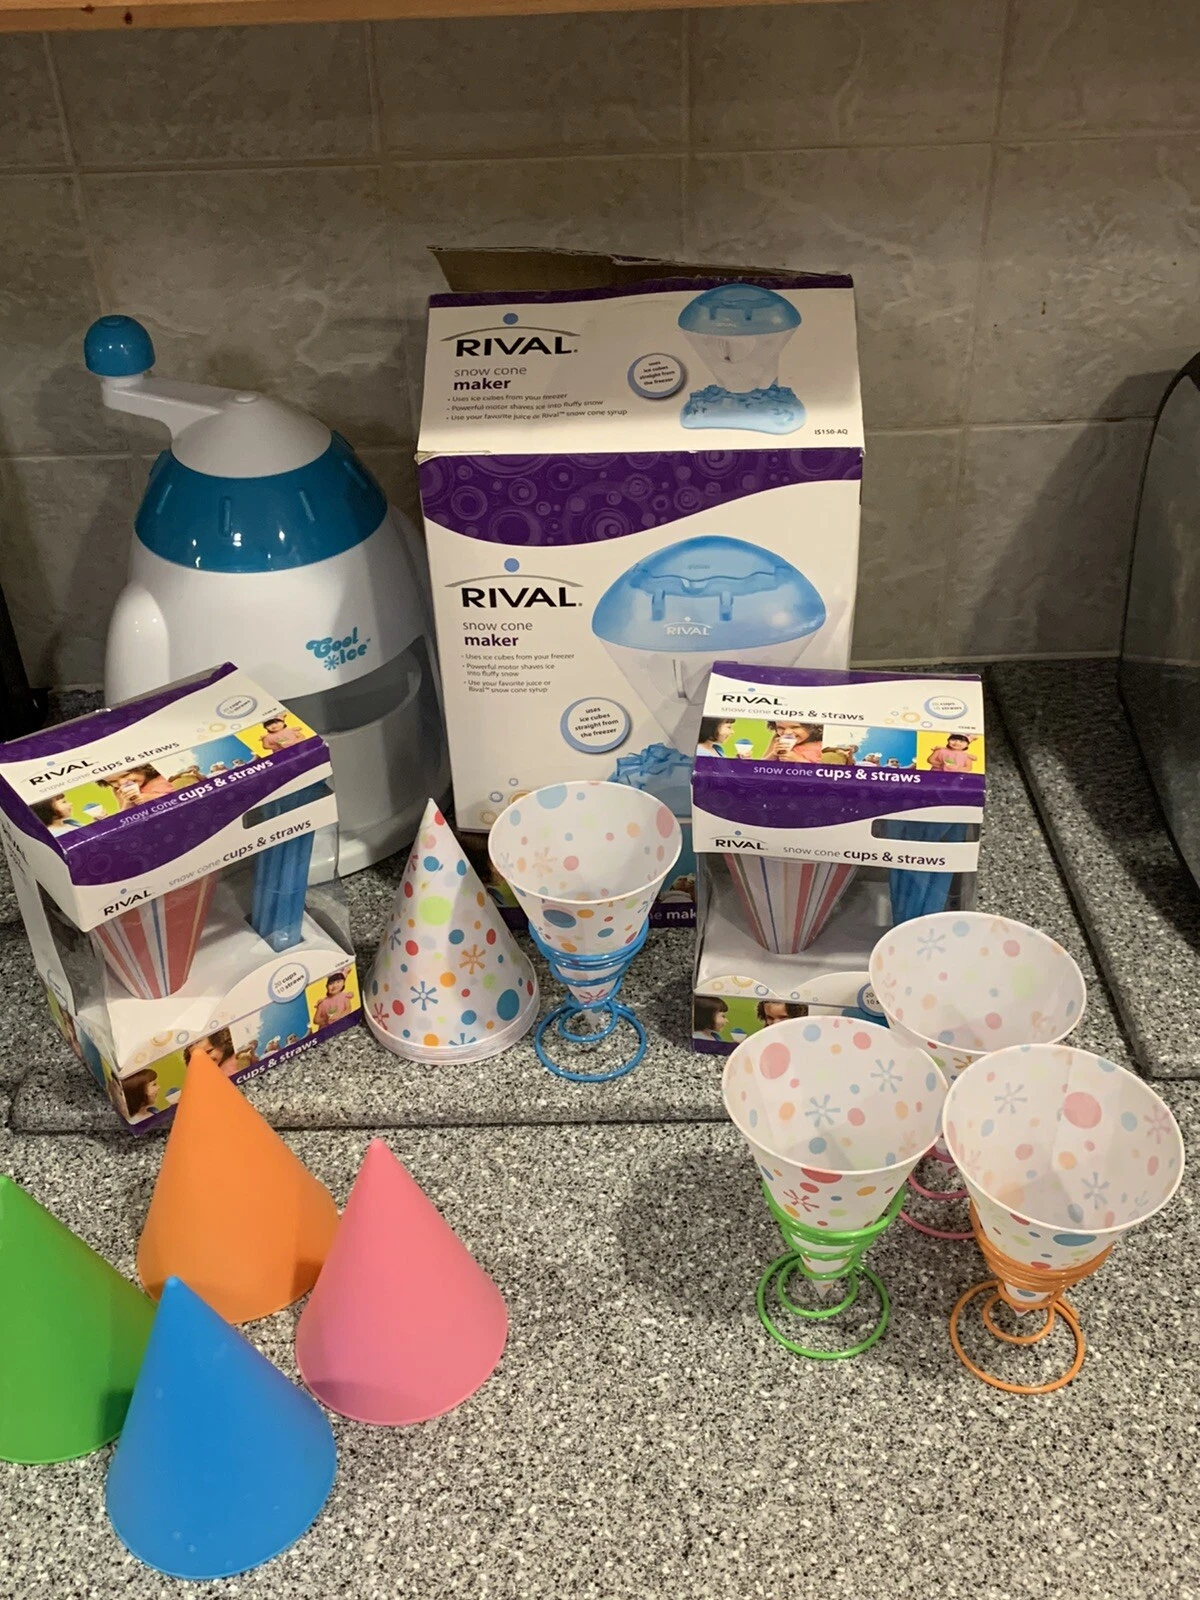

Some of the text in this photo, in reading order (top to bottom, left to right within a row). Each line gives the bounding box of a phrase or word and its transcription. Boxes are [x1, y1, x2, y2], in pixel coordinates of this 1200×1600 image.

[456, 336, 572, 357] RIVAL
[454, 366, 527, 377] snow cone
[453, 378, 511, 390] maker
[563, 400, 582, 408] fluffy
[513, 413, 531, 421] juice
[461, 587, 577, 608] RIVAL
[463, 621, 533, 631] snow cone
[666, 626, 710, 636] RIVAL
[306, 627, 359, 658] Cool
[465, 634, 519, 647] maker
[722, 694, 783, 706] RIVAL
[590, 713, 610, 721] cubes
[773, 709, 804, 718] cups
[808, 710, 818, 718] &
[821, 711, 865, 721] straws
[575, 722, 601, 730] straight
[593, 728, 616, 736] freezer
[29, 760, 93, 786] RIVAL
[39, 742, 180, 793] snow cone cups & straws
[753, 765, 921, 784] snow cone cups & straws
[119, 759, 273, 825] snow cone cups & straws
[715, 838, 765, 851] RIVAL
[168, 819, 312, 887] snow cone cups & straws
[783, 846, 946, 866] snow cone cups & straws
[104, 889, 152, 916] RIVAL
[666, 908, 696, 919] mak
[274, 972, 297, 988] 20 cups
[285, 974, 305, 989] straws
[236, 1038, 318, 1084] cups & straws
